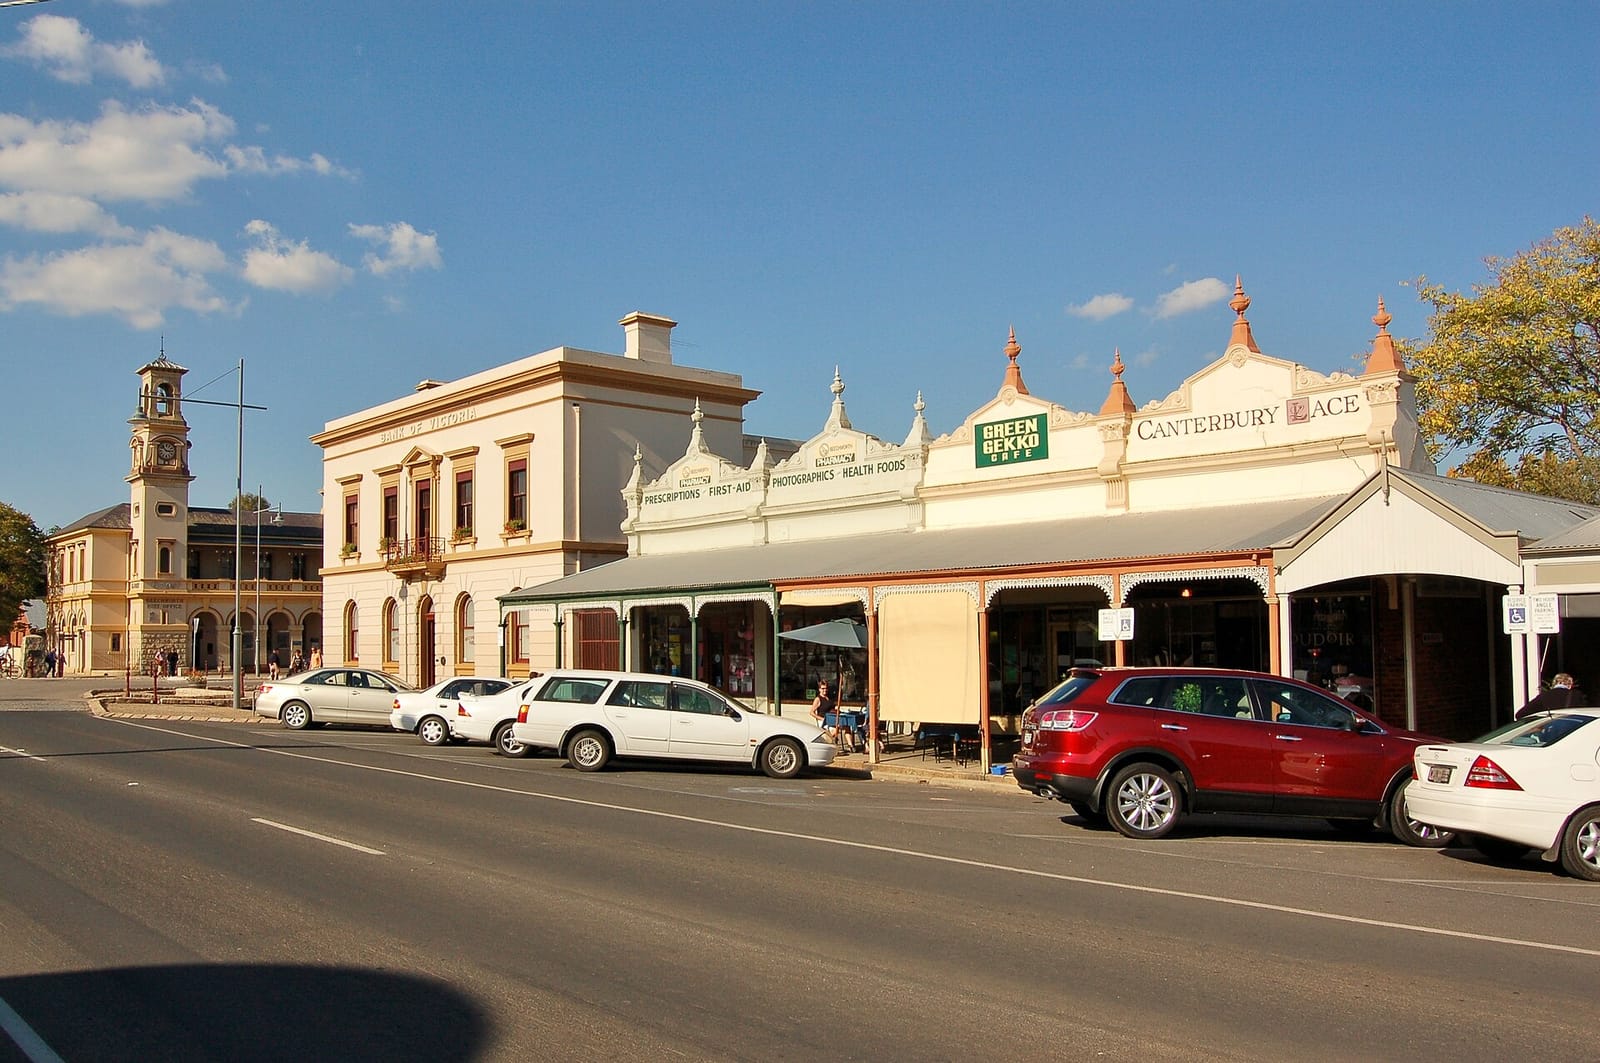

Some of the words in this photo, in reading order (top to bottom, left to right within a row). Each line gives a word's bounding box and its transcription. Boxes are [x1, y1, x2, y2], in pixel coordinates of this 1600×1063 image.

[380, 427, 404, 443] BANK
[411, 422, 422, 435] OF
[431, 408, 477, 430] VICTORIA
[983, 417, 1038, 440] GREEN
[1137, 406, 1280, 441] CANTERBURY
[1287, 394, 1360, 425] LACE
[983, 433, 1040, 455] GEKKO
[991, 449, 1033, 462] CAFE
[816, 454, 854, 467] PHARMACY
[772, 469, 835, 488] PHOTOGRAPHICS
[843, 464, 874, 478] HEALTH
[877, 458, 906, 474] FOODS
[644, 489, 701, 505] PRESCRIPTIONS
[709, 482, 751, 497] FIRST-AID
